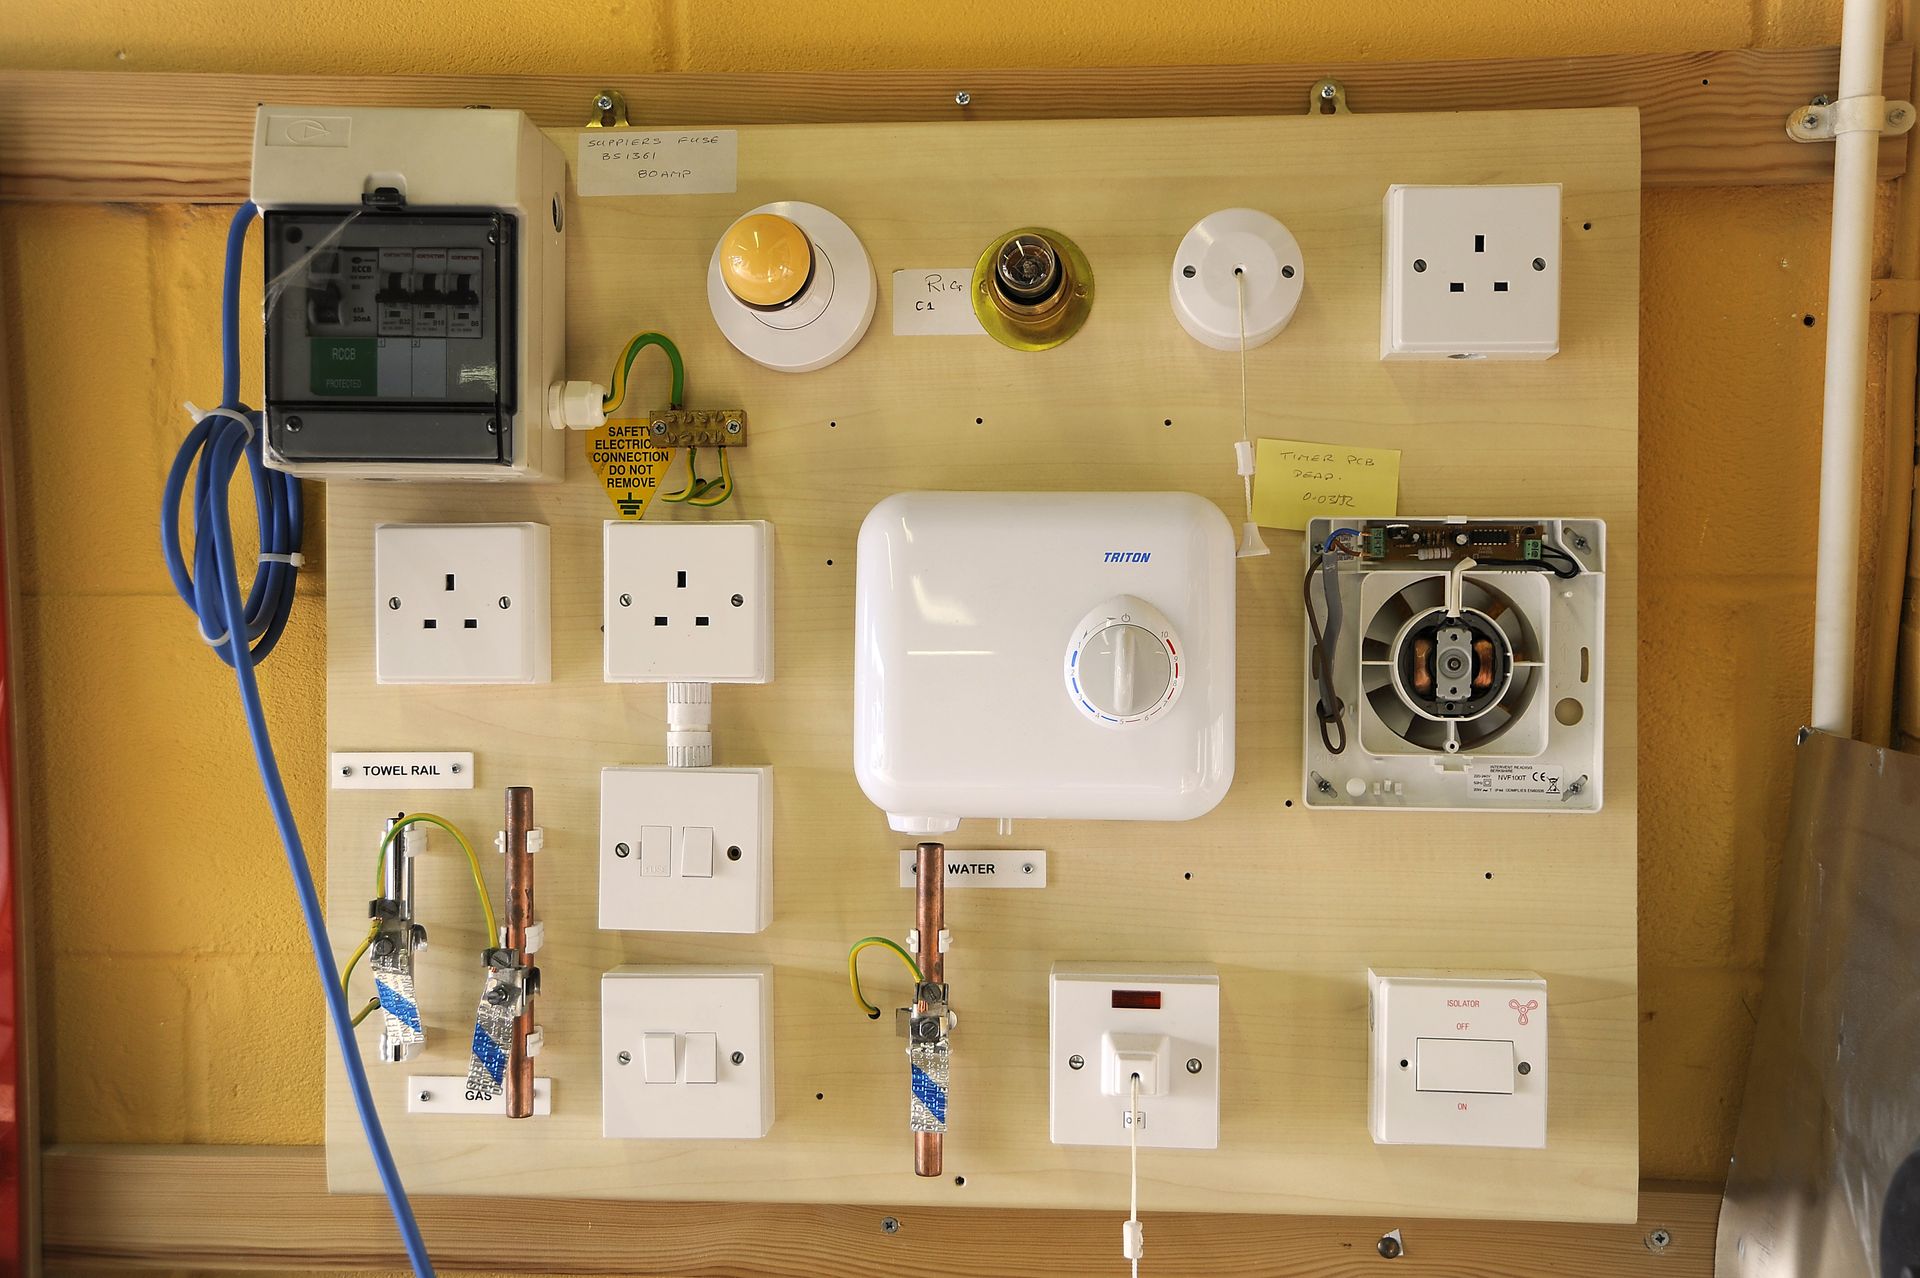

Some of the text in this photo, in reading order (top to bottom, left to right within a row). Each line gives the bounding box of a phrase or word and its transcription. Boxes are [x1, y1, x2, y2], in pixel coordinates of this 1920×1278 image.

[677, 135, 721, 145] FUSE
[332, 347, 357, 361] RCCB
[326, 378, 362, 389] PROTECTED
[608, 426, 650, 437] SAFETY
[595, 439, 668, 450] ELECTRIC
[592, 451, 669, 463] CONNECTION
[1280, 451, 1334, 462] TIMER
[609, 464, 654, 475] DO NOT
[606, 477, 656, 488] REMOVE
[1103, 552, 1152, 563] TRITON
[362, 765, 441, 776] TOWEL RAIL
[947, 863, 996, 874] WATER
[1447, 999, 1480, 1008] ISOLATOR
[1456, 1022, 1470, 1031] OFF
[465, 1090, 493, 1101] GAS
[1457, 1102, 1468, 1111] ON
